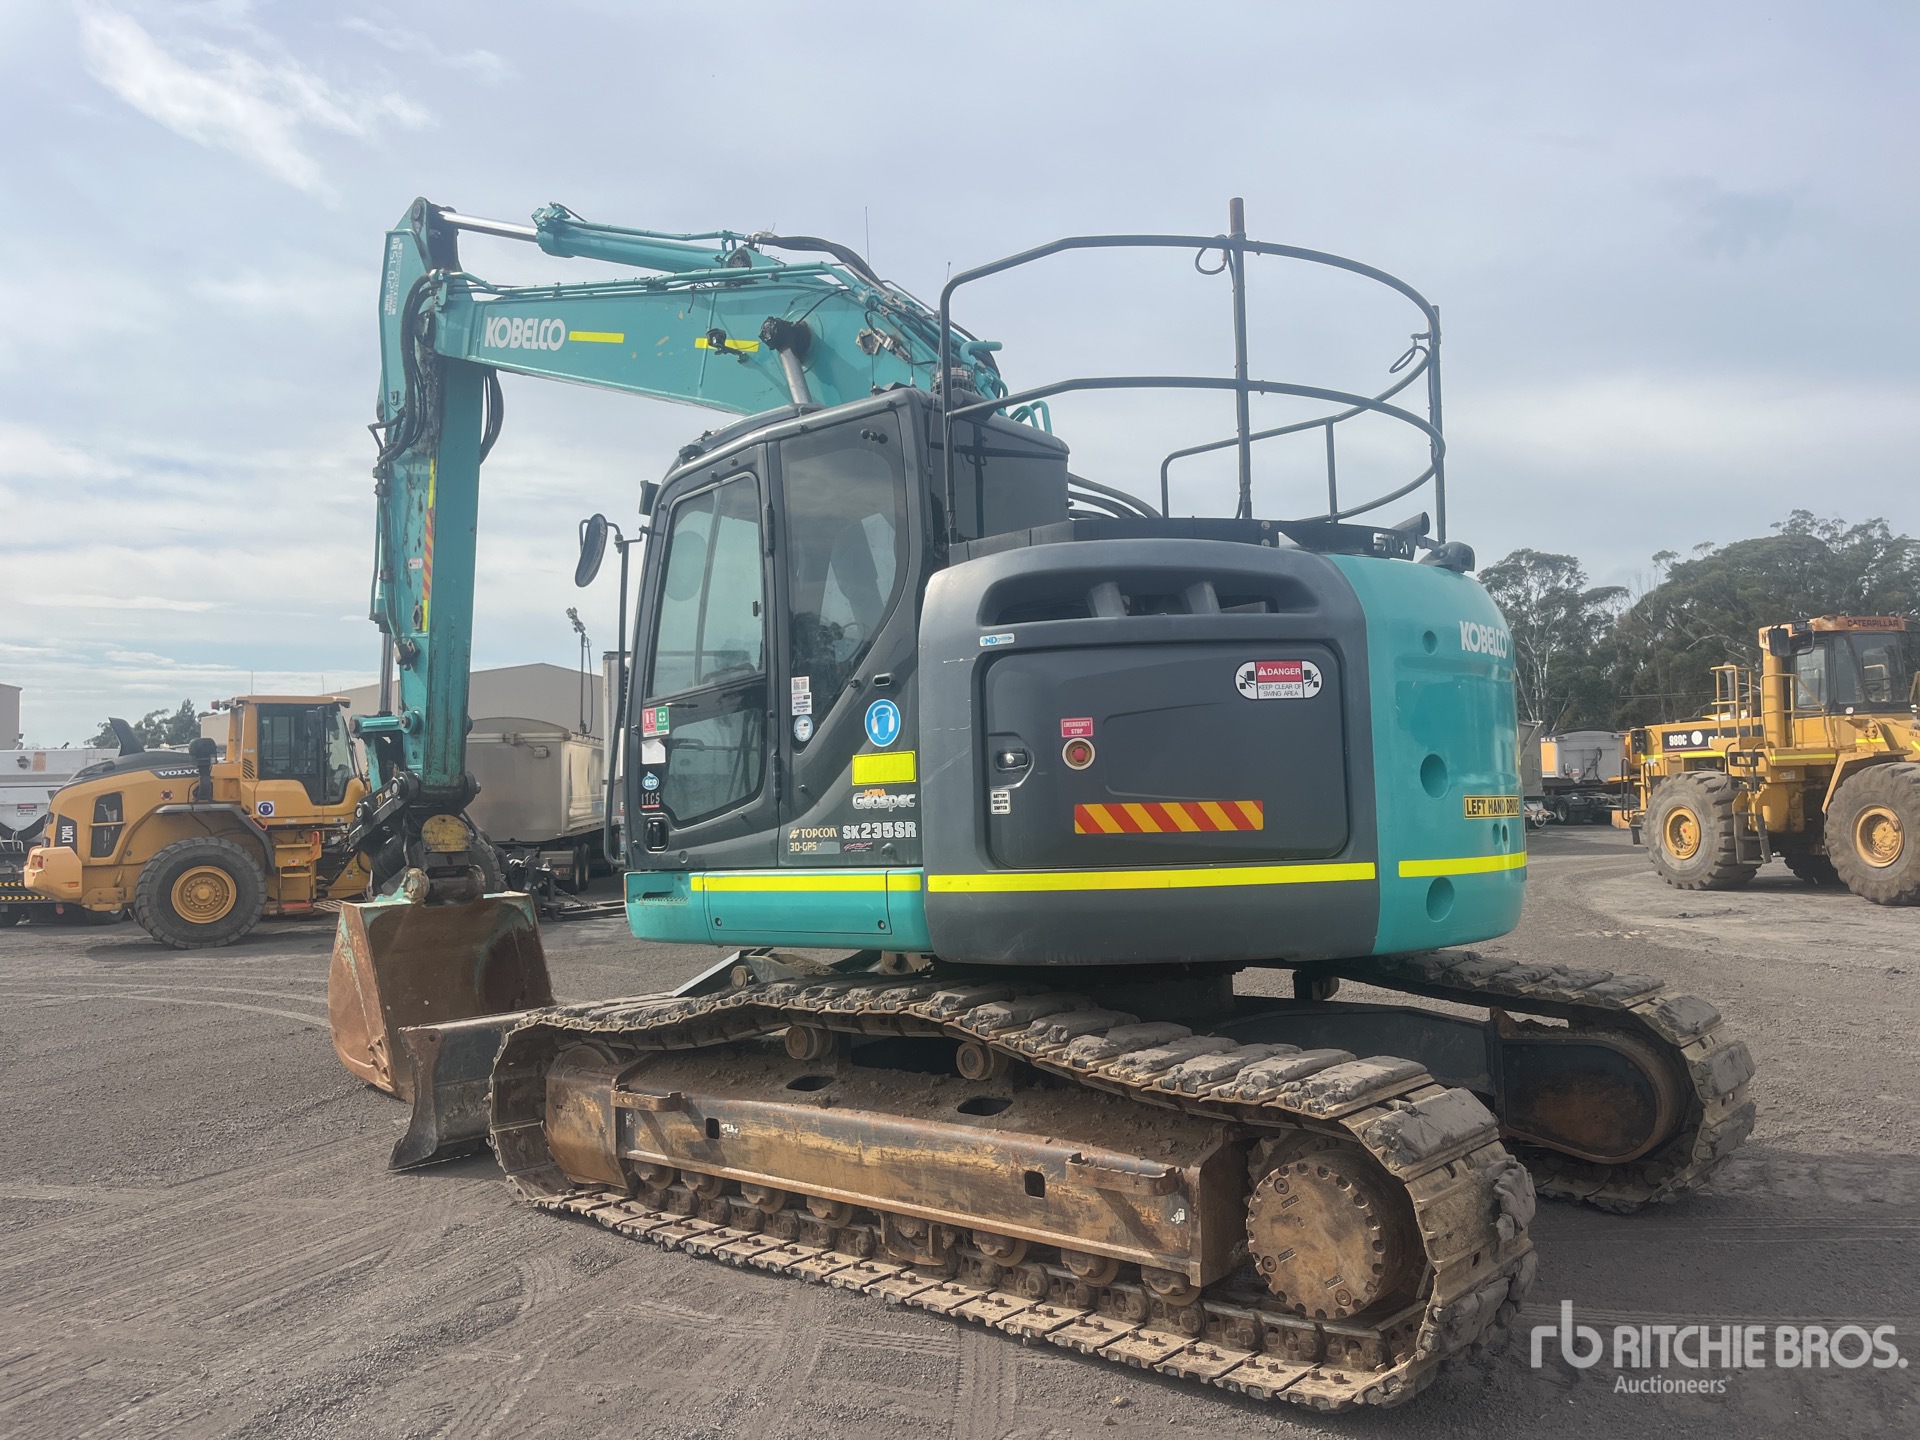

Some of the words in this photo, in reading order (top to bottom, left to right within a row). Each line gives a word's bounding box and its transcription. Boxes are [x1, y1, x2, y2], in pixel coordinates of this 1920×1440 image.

[484, 316, 566, 351] KOBELCO
[1847, 619, 1899, 627] CATERPILLAR
[1459, 620, 1507, 659] KOBELCO
[1267, 667, 1301, 676] DANGER
[1668, 734, 1688, 746] 980C
[853, 792, 916, 812] Geospec
[1466, 799, 1486, 815] LEFT
[1487, 798, 1505, 814] HAND
[62, 825, 73, 843] L70H
[800, 827, 838, 839] TOPCON
[842, 821, 917, 840] SK235SR
[789, 841, 817, 852] 3D-GPS
